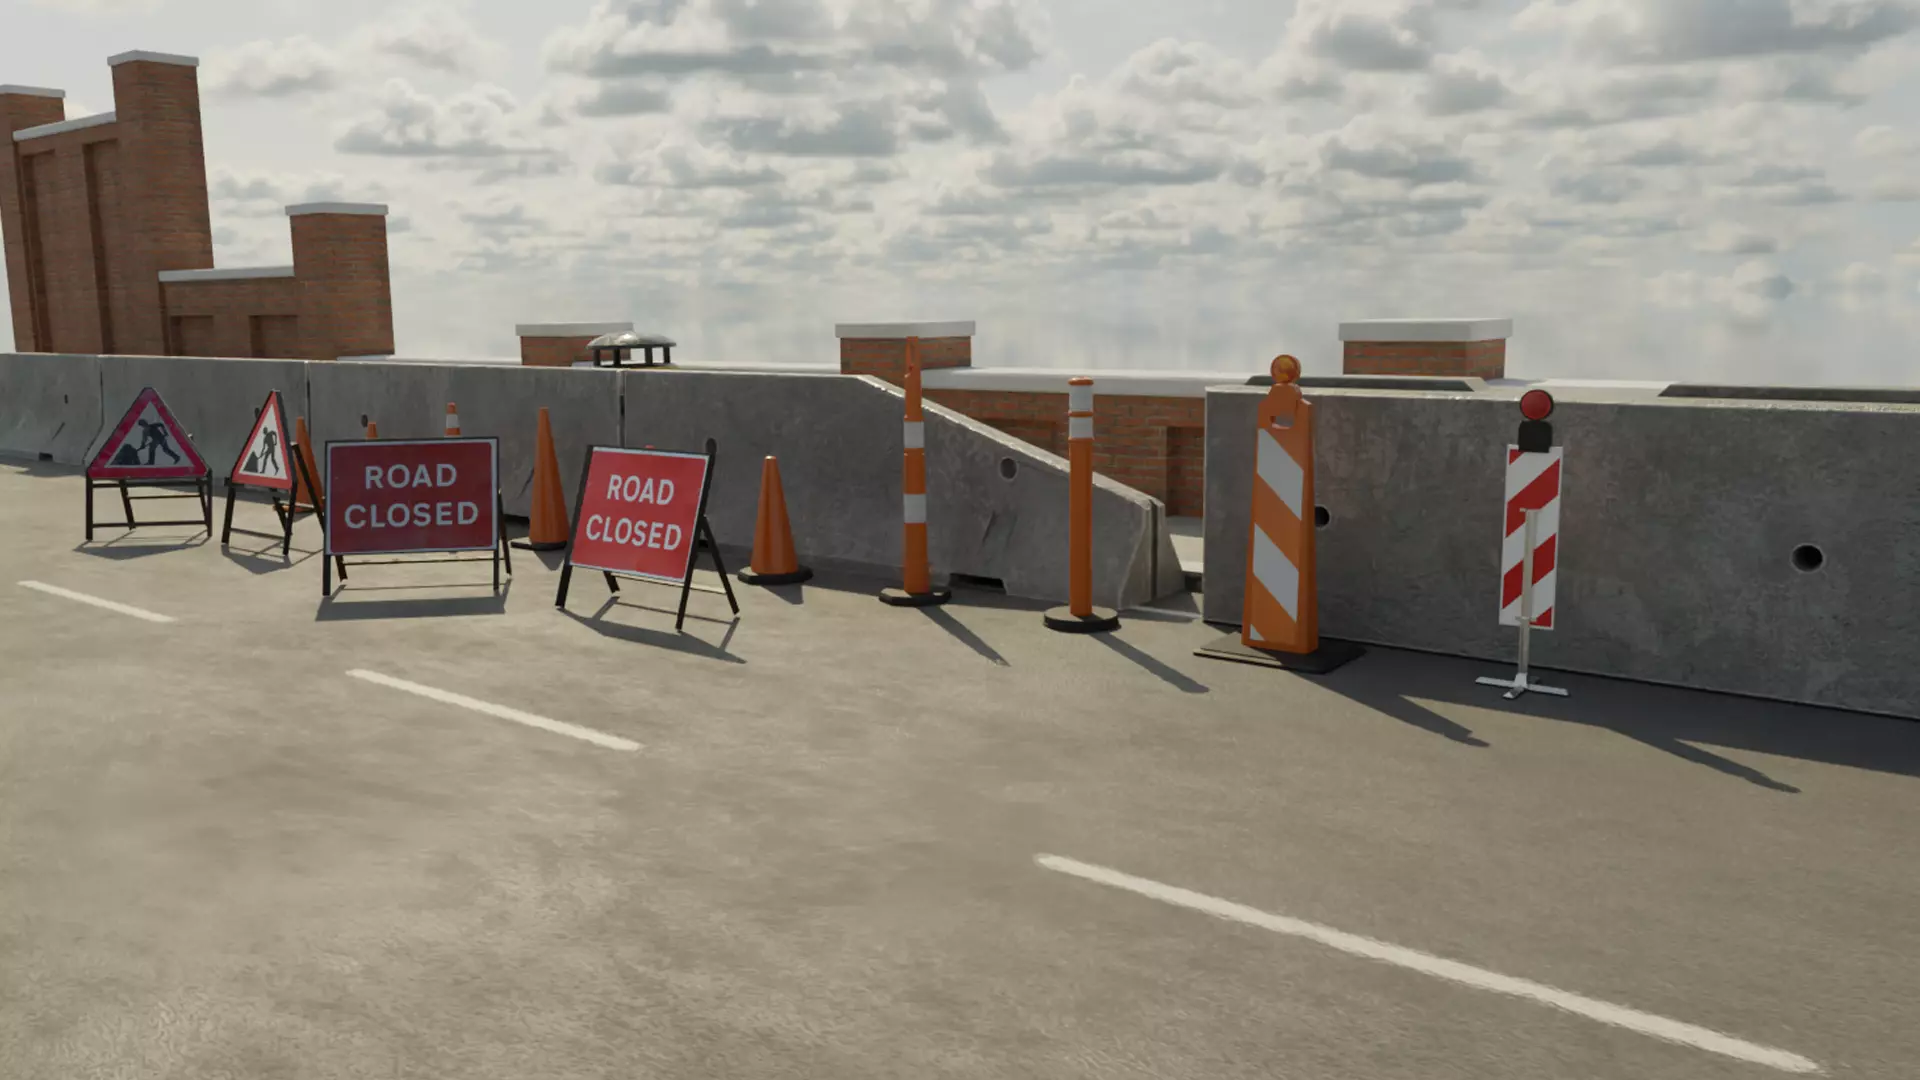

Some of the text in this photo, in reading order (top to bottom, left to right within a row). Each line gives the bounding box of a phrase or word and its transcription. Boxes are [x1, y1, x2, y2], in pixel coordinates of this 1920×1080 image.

[365, 463, 457, 489] ROAD
[607, 474, 675, 506] ROAD
[344, 501, 479, 529] CLOSED
[586, 514, 682, 551] CLOSED
